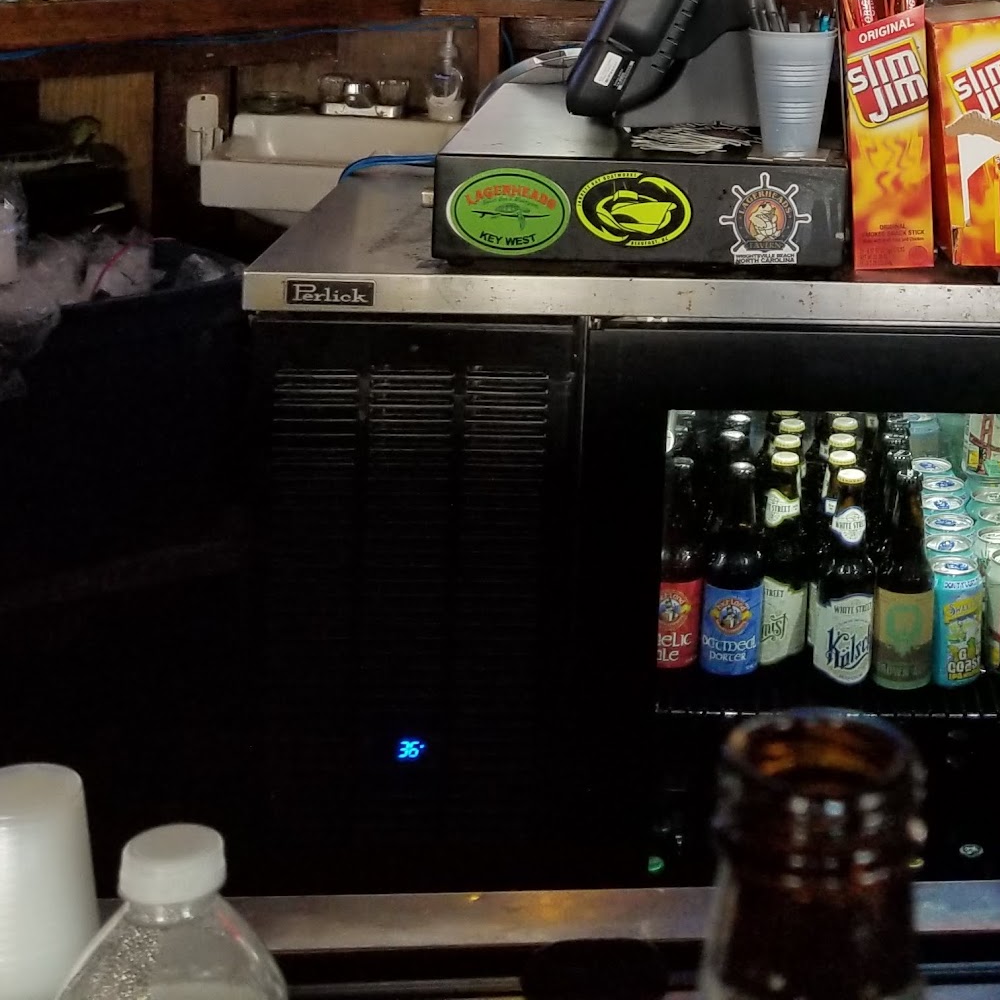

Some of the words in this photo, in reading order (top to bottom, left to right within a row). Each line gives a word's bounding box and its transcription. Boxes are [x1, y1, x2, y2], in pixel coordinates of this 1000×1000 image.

[859, 17, 914, 44] ORIGINAL
[465, 184, 557, 210] LAGERHEADS
[739, 190, 791, 215] LAGERHEADS
[480, 230, 503, 245] KEY
[505, 233, 537, 246] WEST
[750, 241, 781, 249] TAVERN
[292, 284, 368, 303] Perlick
[764, 589, 784, 599] TREET
[834, 604, 854, 614] WHITE
